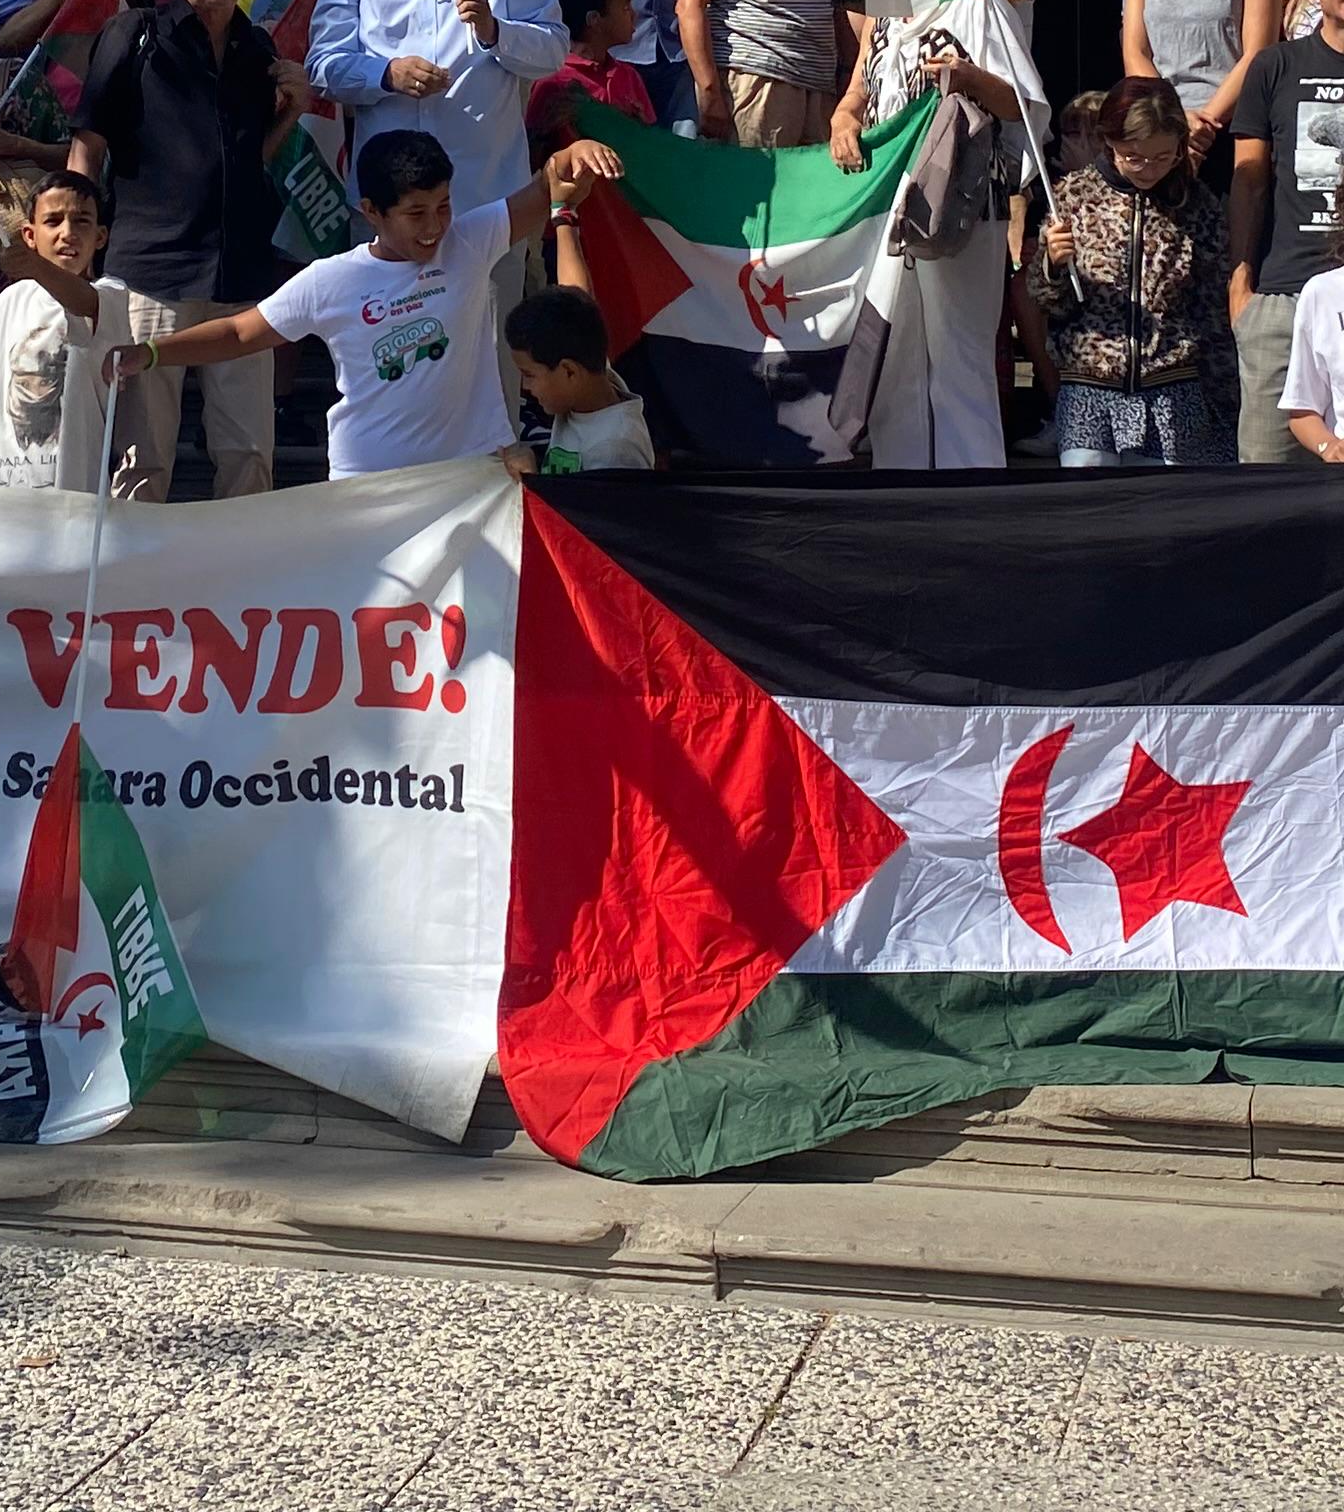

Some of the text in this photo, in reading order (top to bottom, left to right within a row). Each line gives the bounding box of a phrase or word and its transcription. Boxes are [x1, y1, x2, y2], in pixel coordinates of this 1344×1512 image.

[1314, 86, 1344, 100] NO
[284, 151, 351, 243] LIBRE
[389, 286, 447, 307] vacaciones
[405, 301, 424, 315] paz
[6, 603, 467, 714] VENDE!
[179, 755, 466, 814] Occidental
